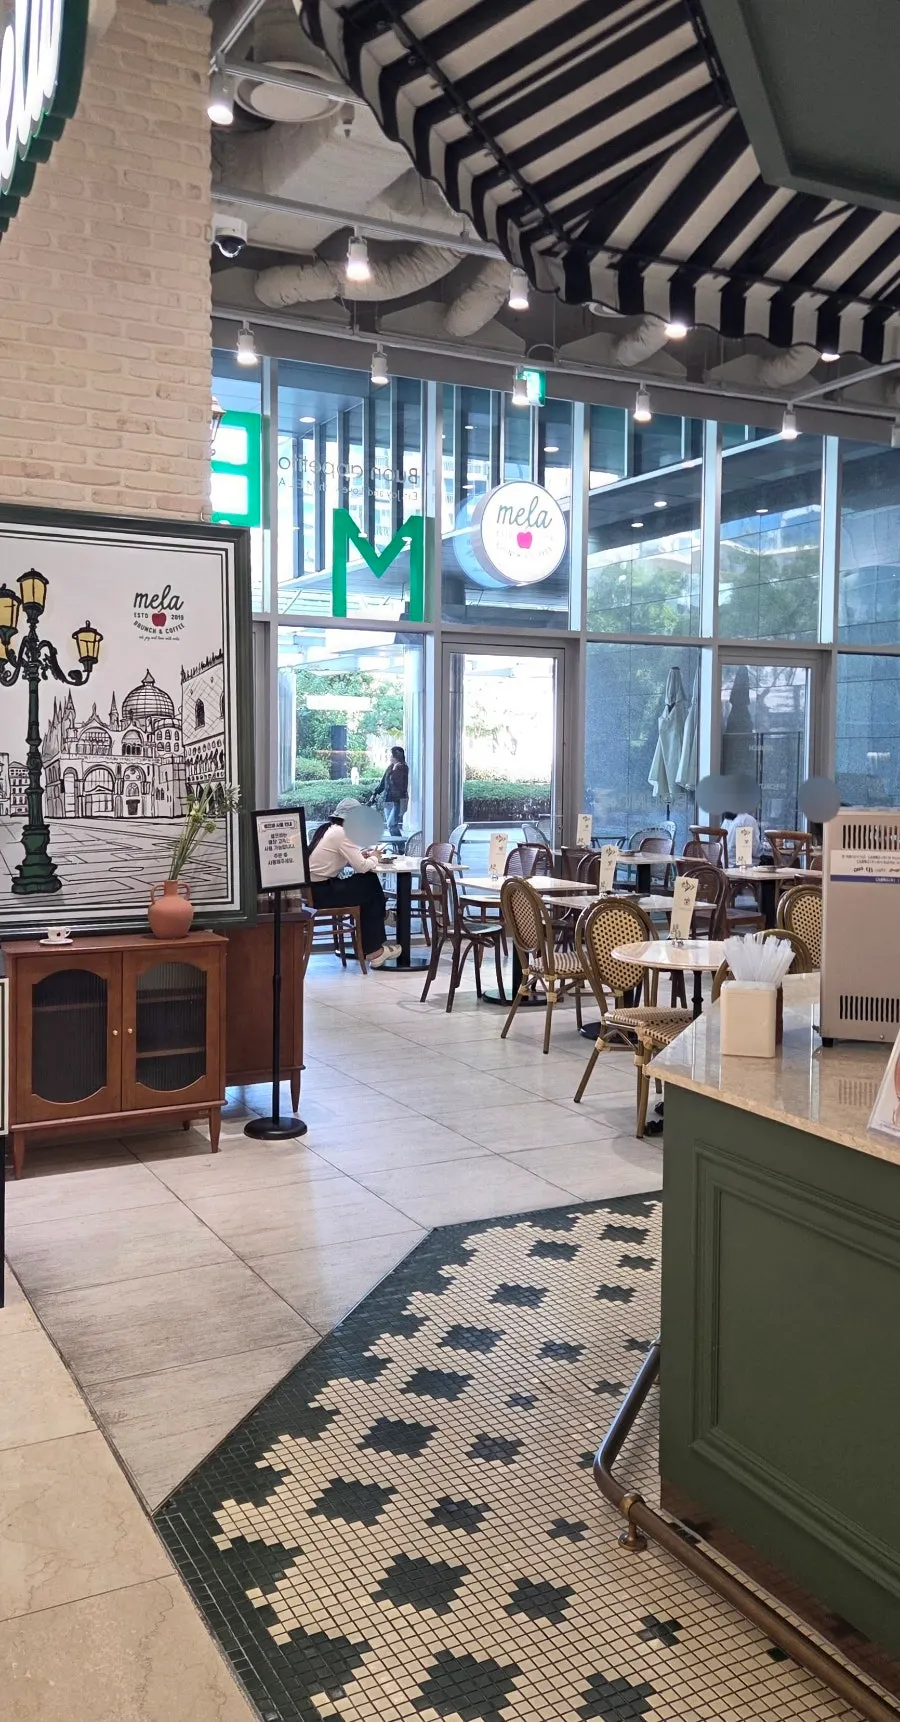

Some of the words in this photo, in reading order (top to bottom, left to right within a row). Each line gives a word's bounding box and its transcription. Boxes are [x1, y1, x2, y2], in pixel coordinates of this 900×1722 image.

[496, 496, 553, 529] mela
[133, 584, 184, 612] mela
[133, 620, 157, 634] BRUNCH
[165, 622, 185, 634] COFFEE
